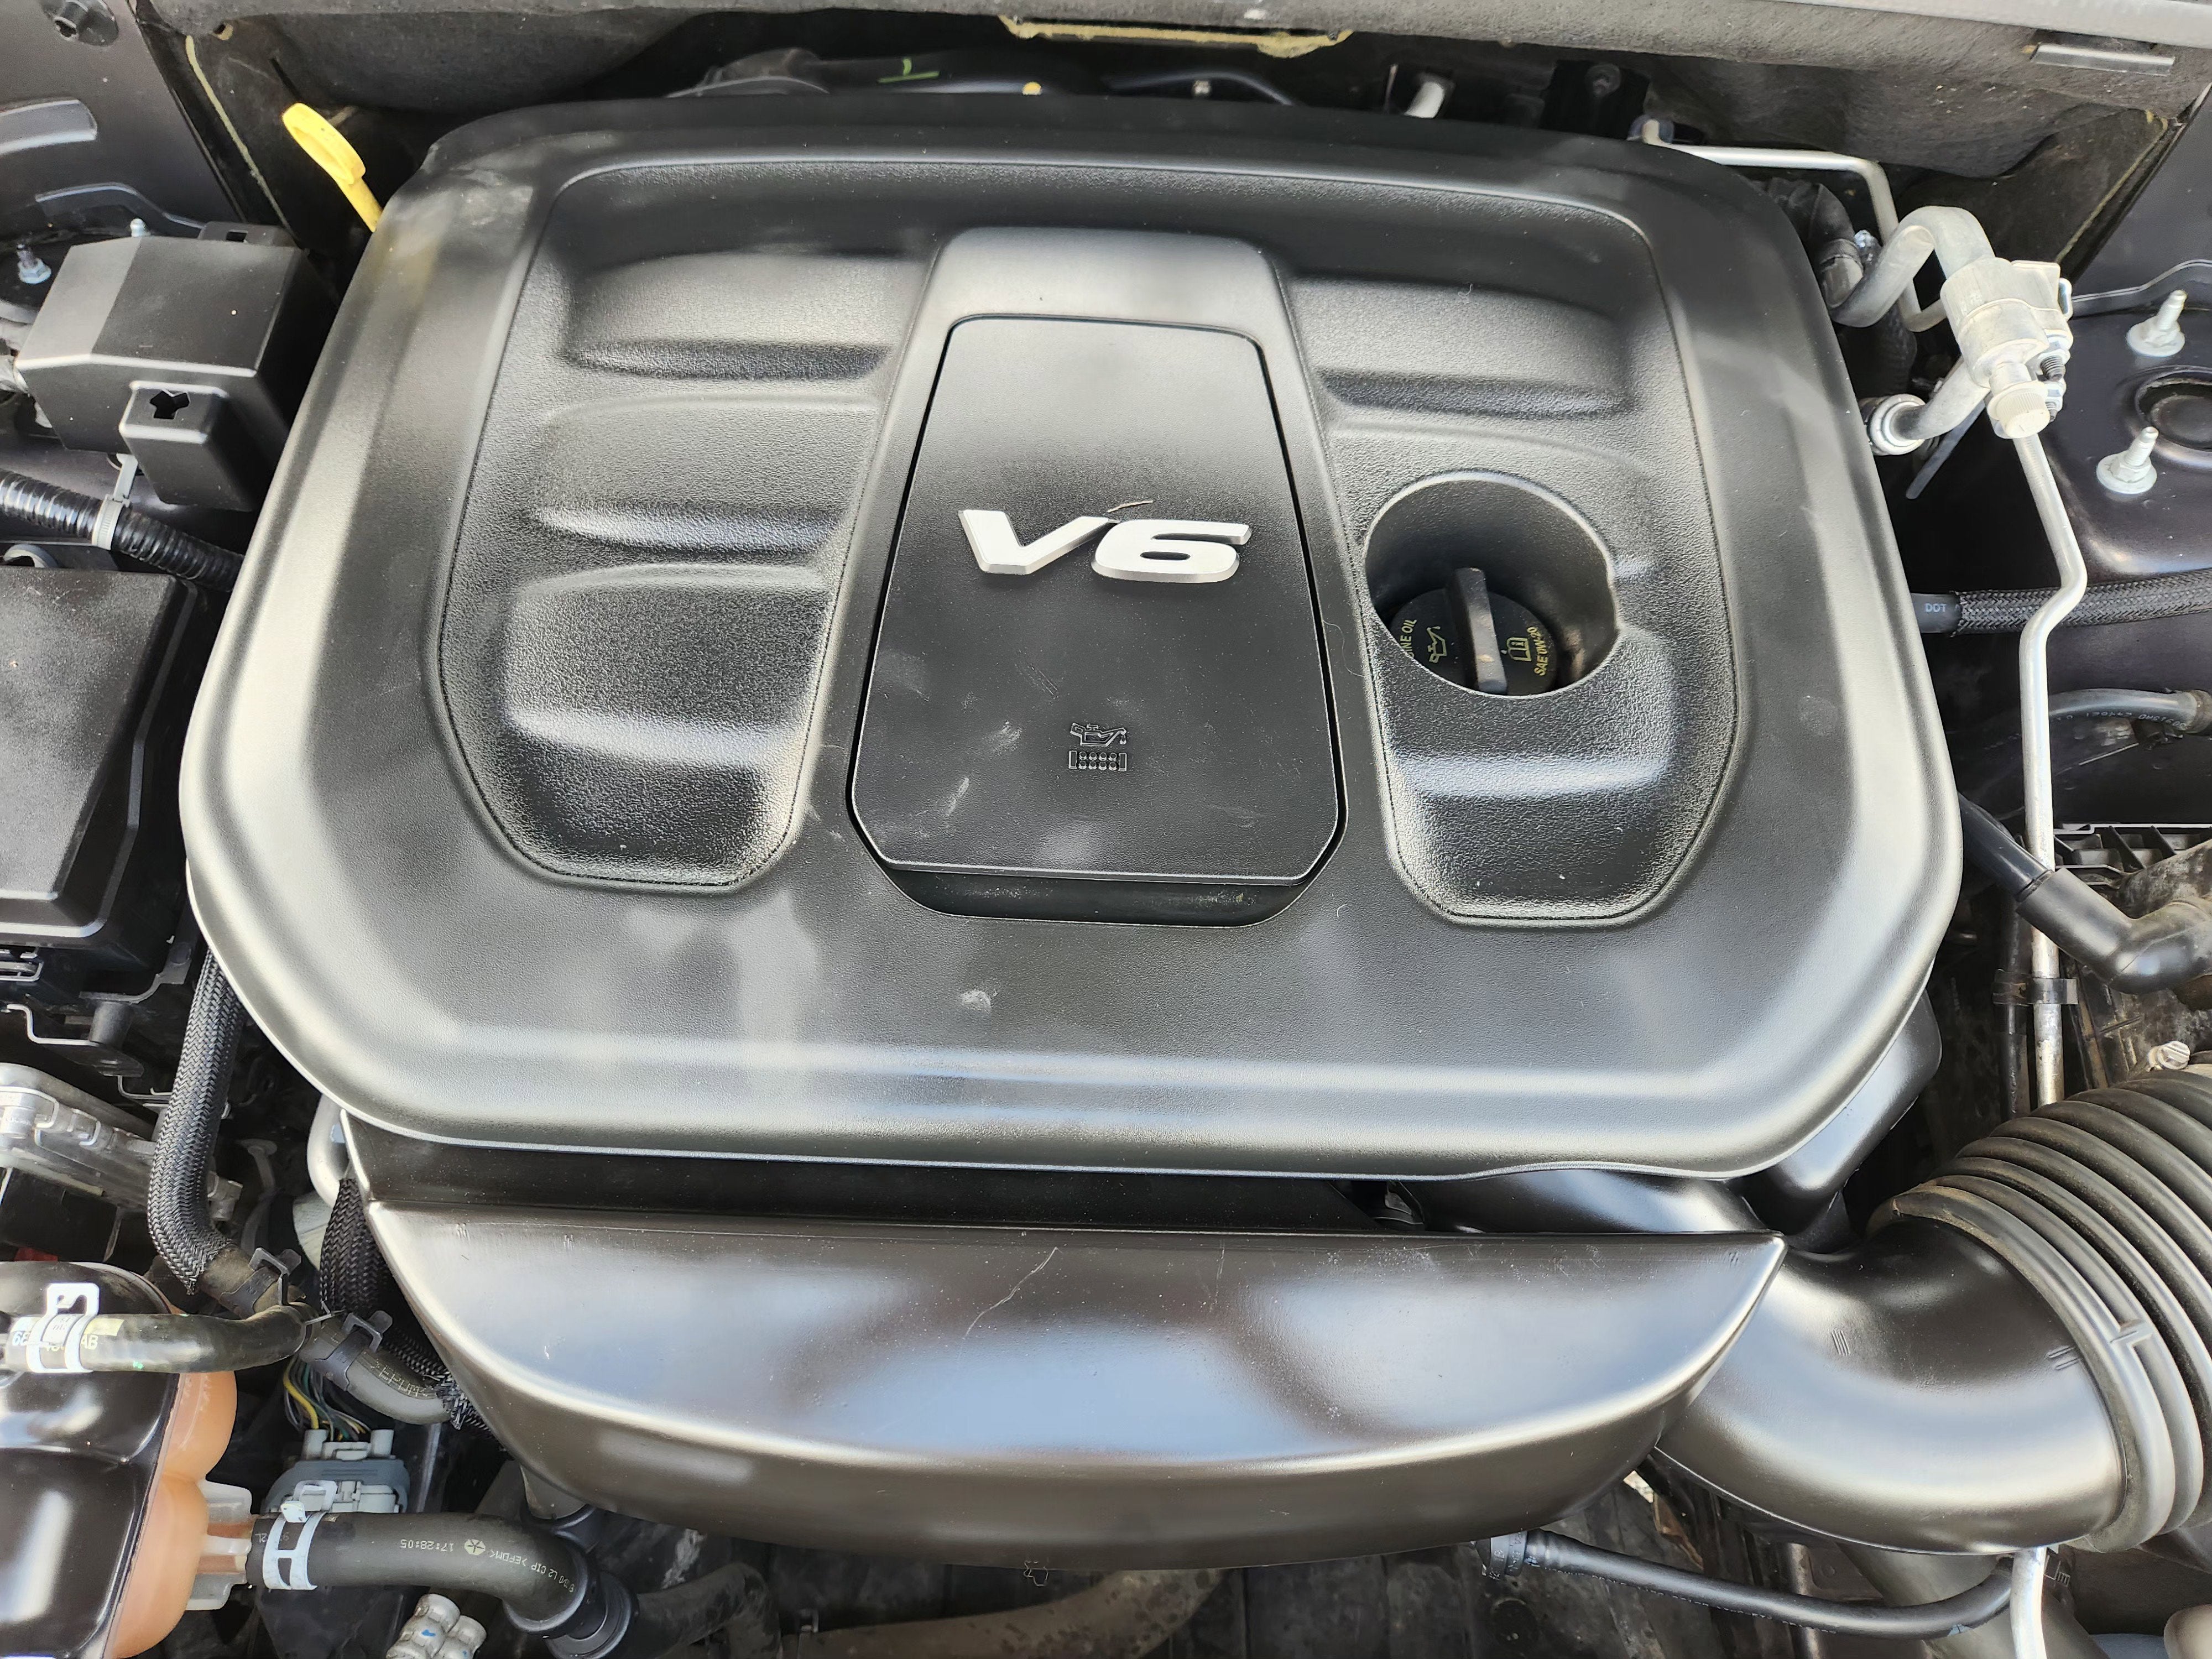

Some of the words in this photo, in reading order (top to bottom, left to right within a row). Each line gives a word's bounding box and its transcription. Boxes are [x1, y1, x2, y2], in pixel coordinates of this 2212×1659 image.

[958, 509, 1251, 583] V6
[1925, 603, 1947, 612] DOT
[1401, 619, 1417, 633] OIL
[1534, 656, 1548, 676] SAE
[400, 1539, 454, 1552] 17:28:05
